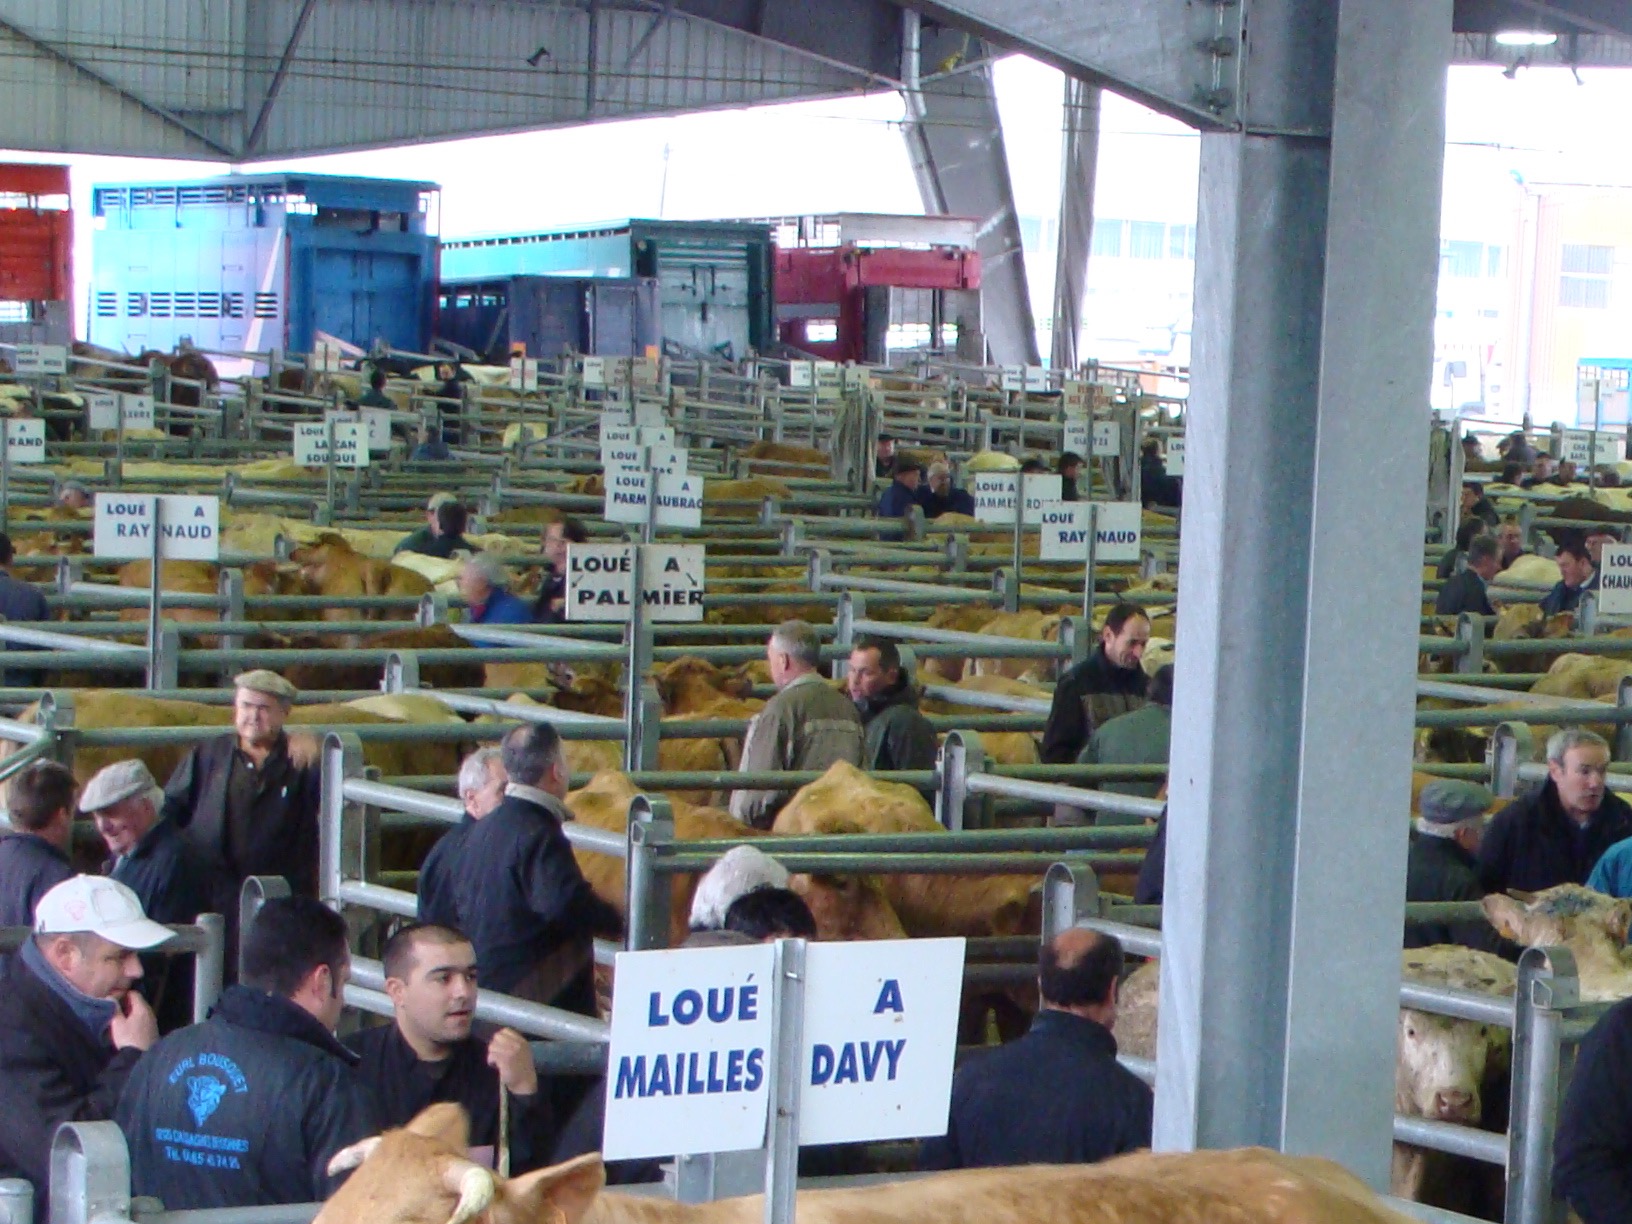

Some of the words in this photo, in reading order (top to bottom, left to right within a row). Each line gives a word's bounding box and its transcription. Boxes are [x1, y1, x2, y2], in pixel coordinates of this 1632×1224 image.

[194, 505, 205, 518] A
[664, 556, 681, 573] A
[648, 973, 760, 1027] LOUÉ
[873, 979, 904, 1014] A
[614, 1048, 764, 1100] MAILLES
[811, 1039, 907, 1086] DAVY
